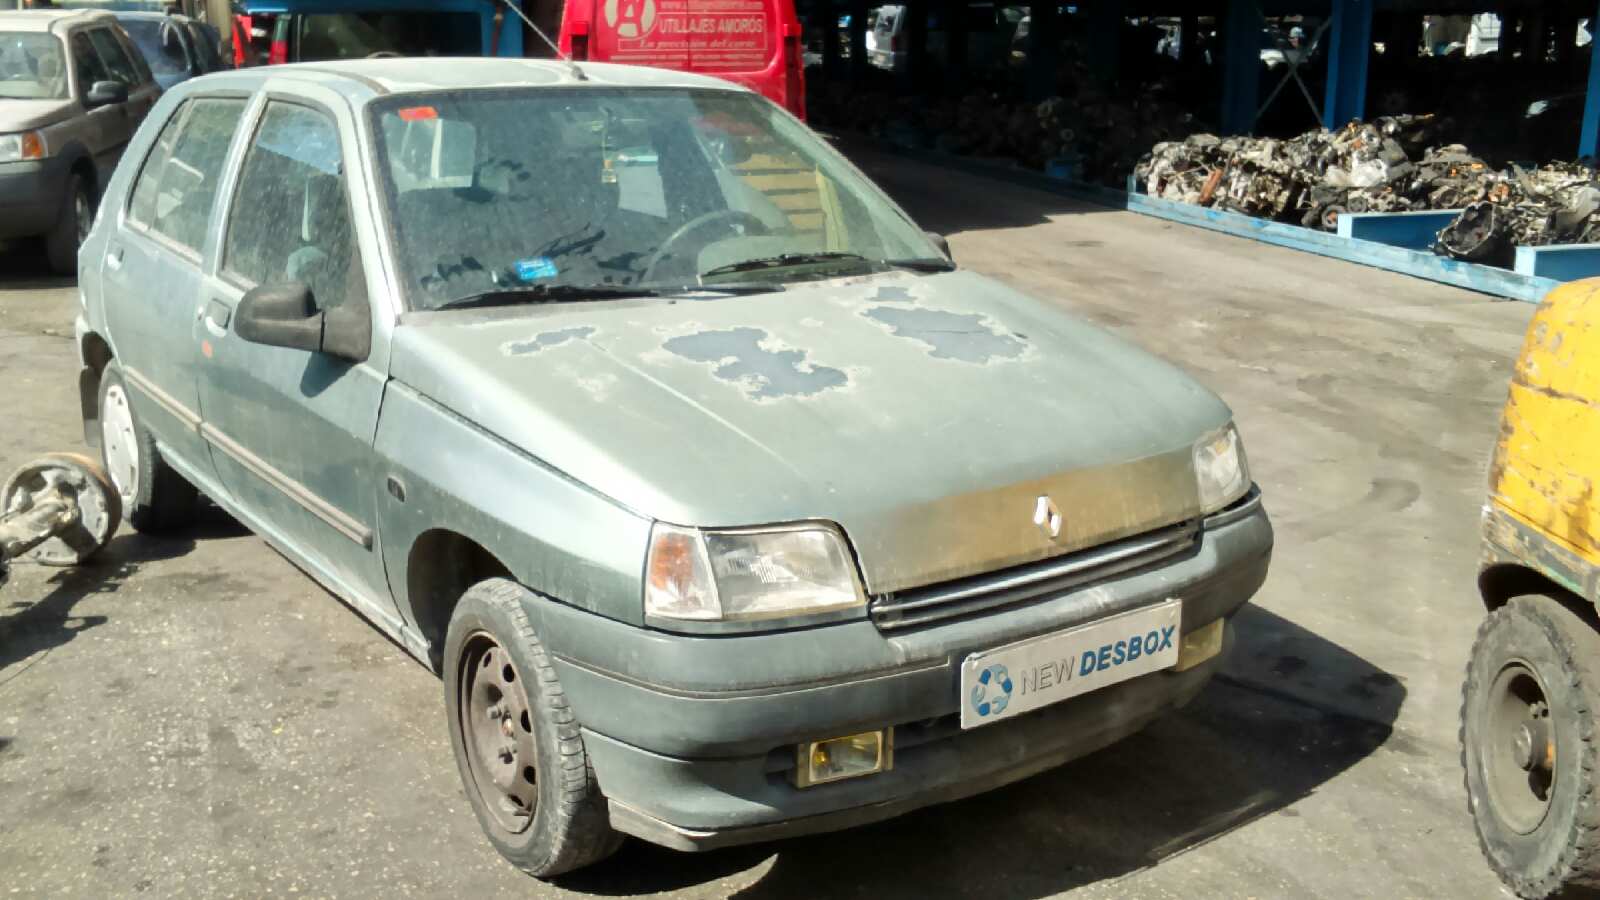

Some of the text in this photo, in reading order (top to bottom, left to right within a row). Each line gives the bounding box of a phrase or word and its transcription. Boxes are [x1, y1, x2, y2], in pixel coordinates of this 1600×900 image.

[659, 15, 763, 33] UTILLAJES AMORÓS
[1020, 624, 1176, 695] NEW DESBOX
